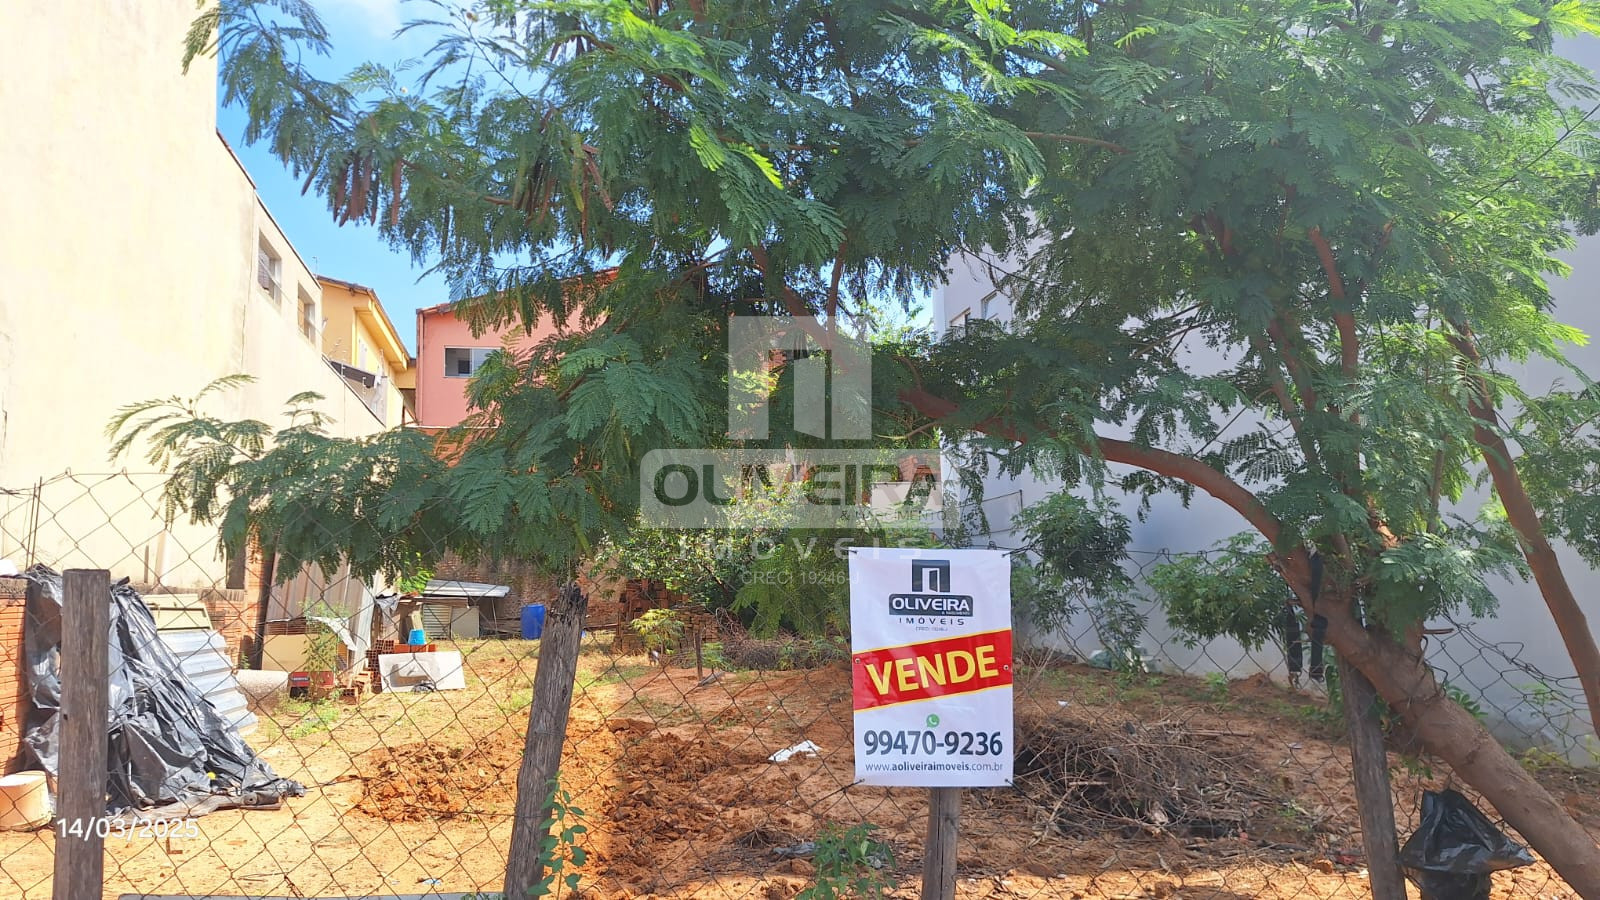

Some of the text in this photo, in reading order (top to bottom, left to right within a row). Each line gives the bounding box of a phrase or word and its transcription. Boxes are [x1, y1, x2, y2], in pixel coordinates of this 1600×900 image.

[892, 597, 970, 611] OLIVEIRA
[899, 616, 965, 626] IMÓVEIS
[865, 644, 999, 696] VENDE
[863, 729, 1003, 757] 99470-9236
[865, 760, 1003, 772] www.aoliveiraimoveis.com.br
